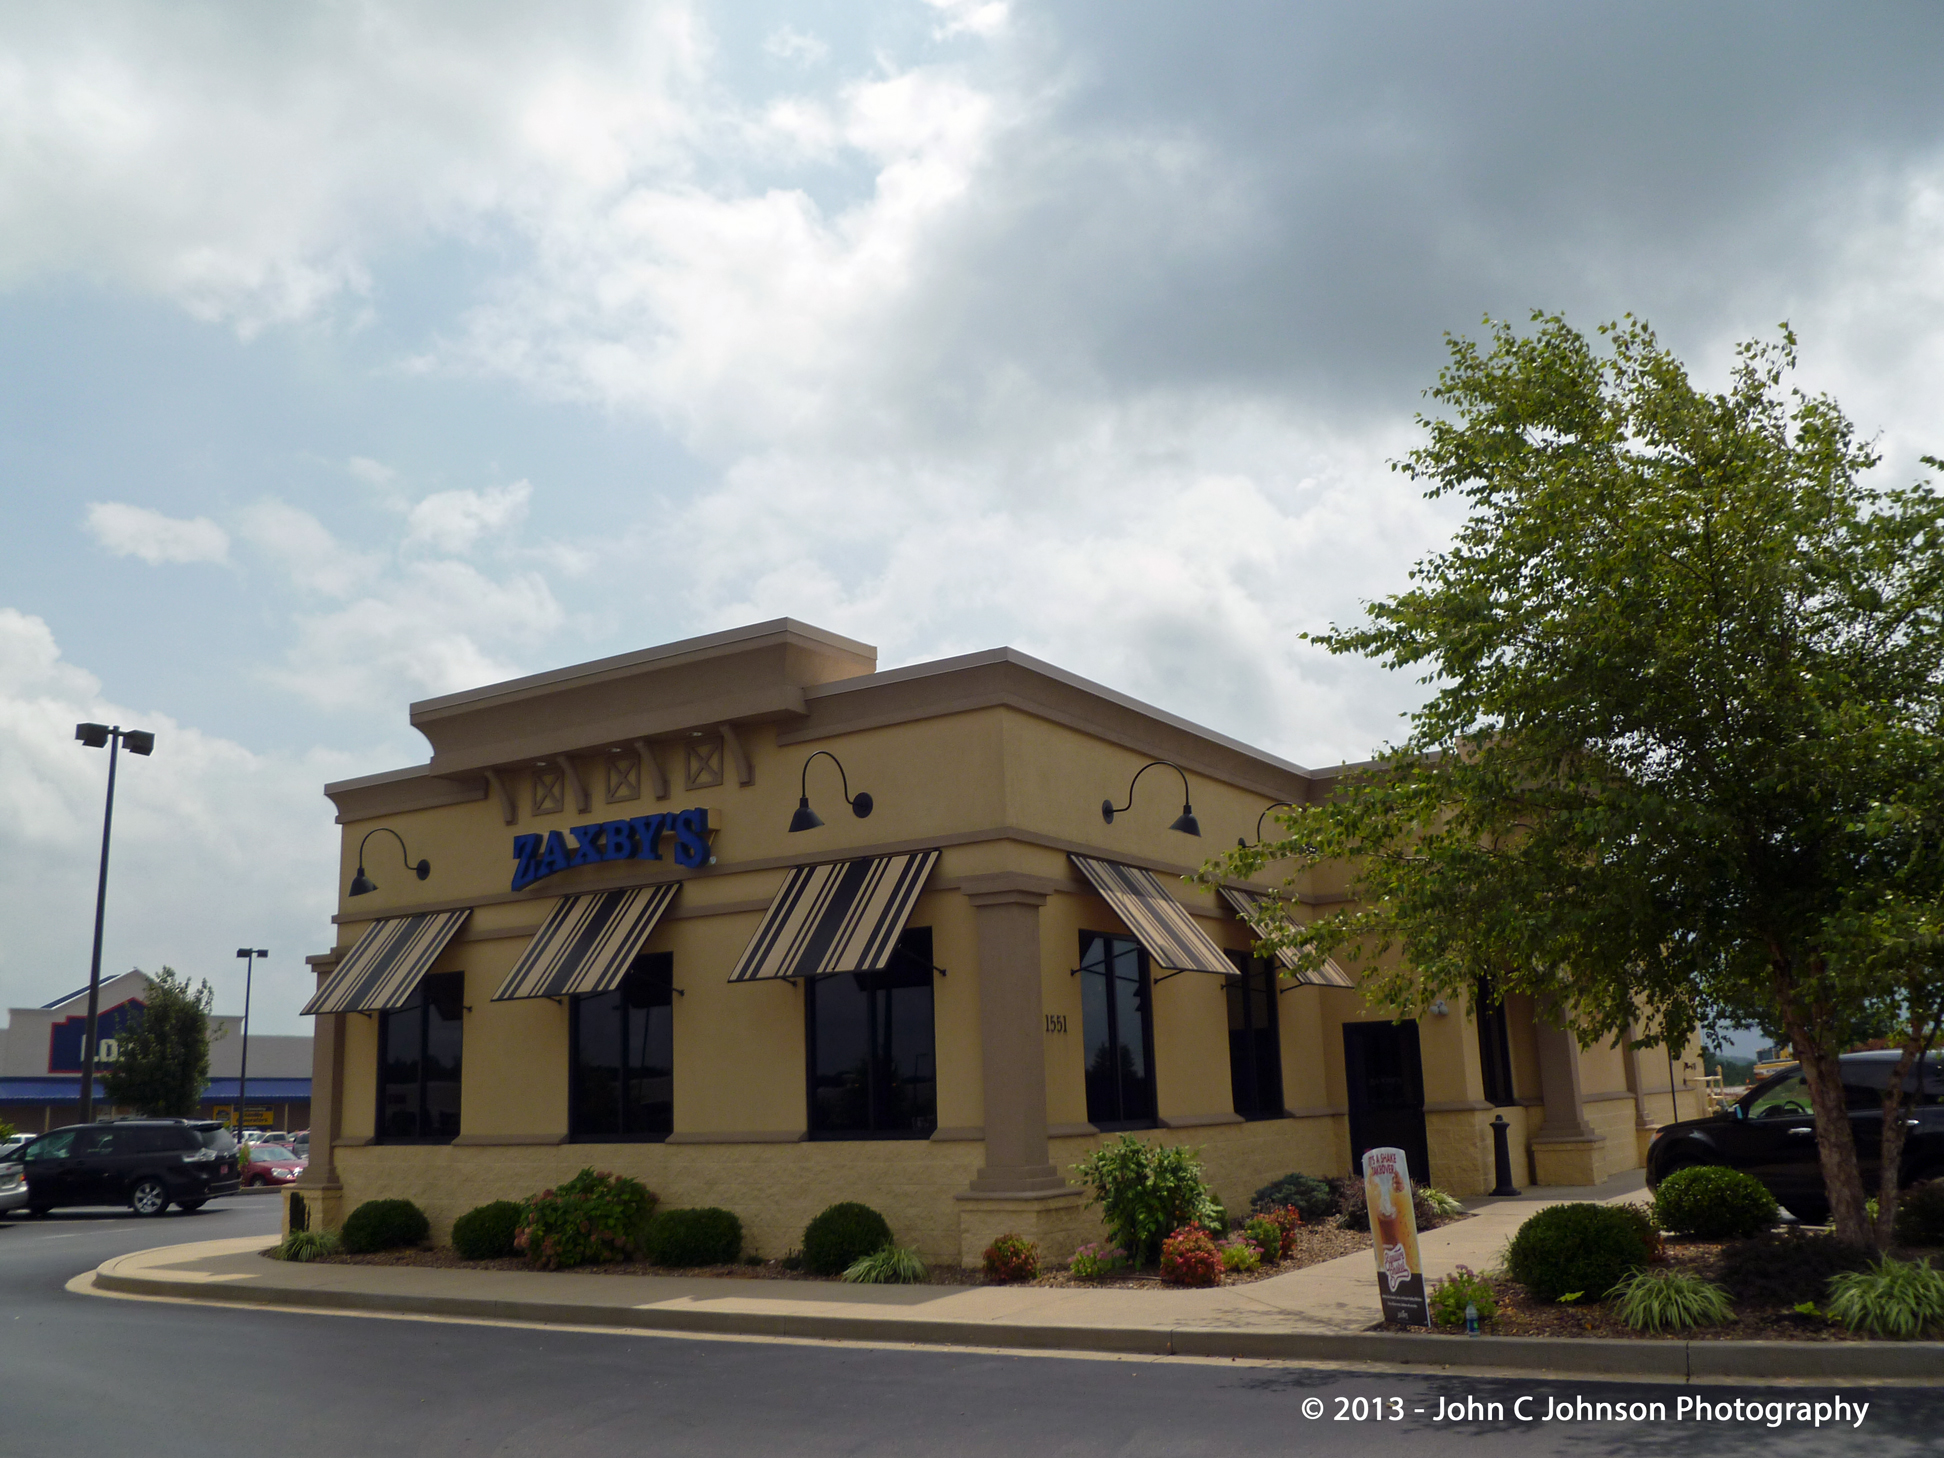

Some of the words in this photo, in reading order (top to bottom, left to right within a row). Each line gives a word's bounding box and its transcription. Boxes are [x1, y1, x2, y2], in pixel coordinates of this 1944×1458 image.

[511, 807, 711, 892] ZAXBY'S
[1045, 1014, 1068, 1033] 1551
[1380, 1152, 1397, 1164] SHAKE
